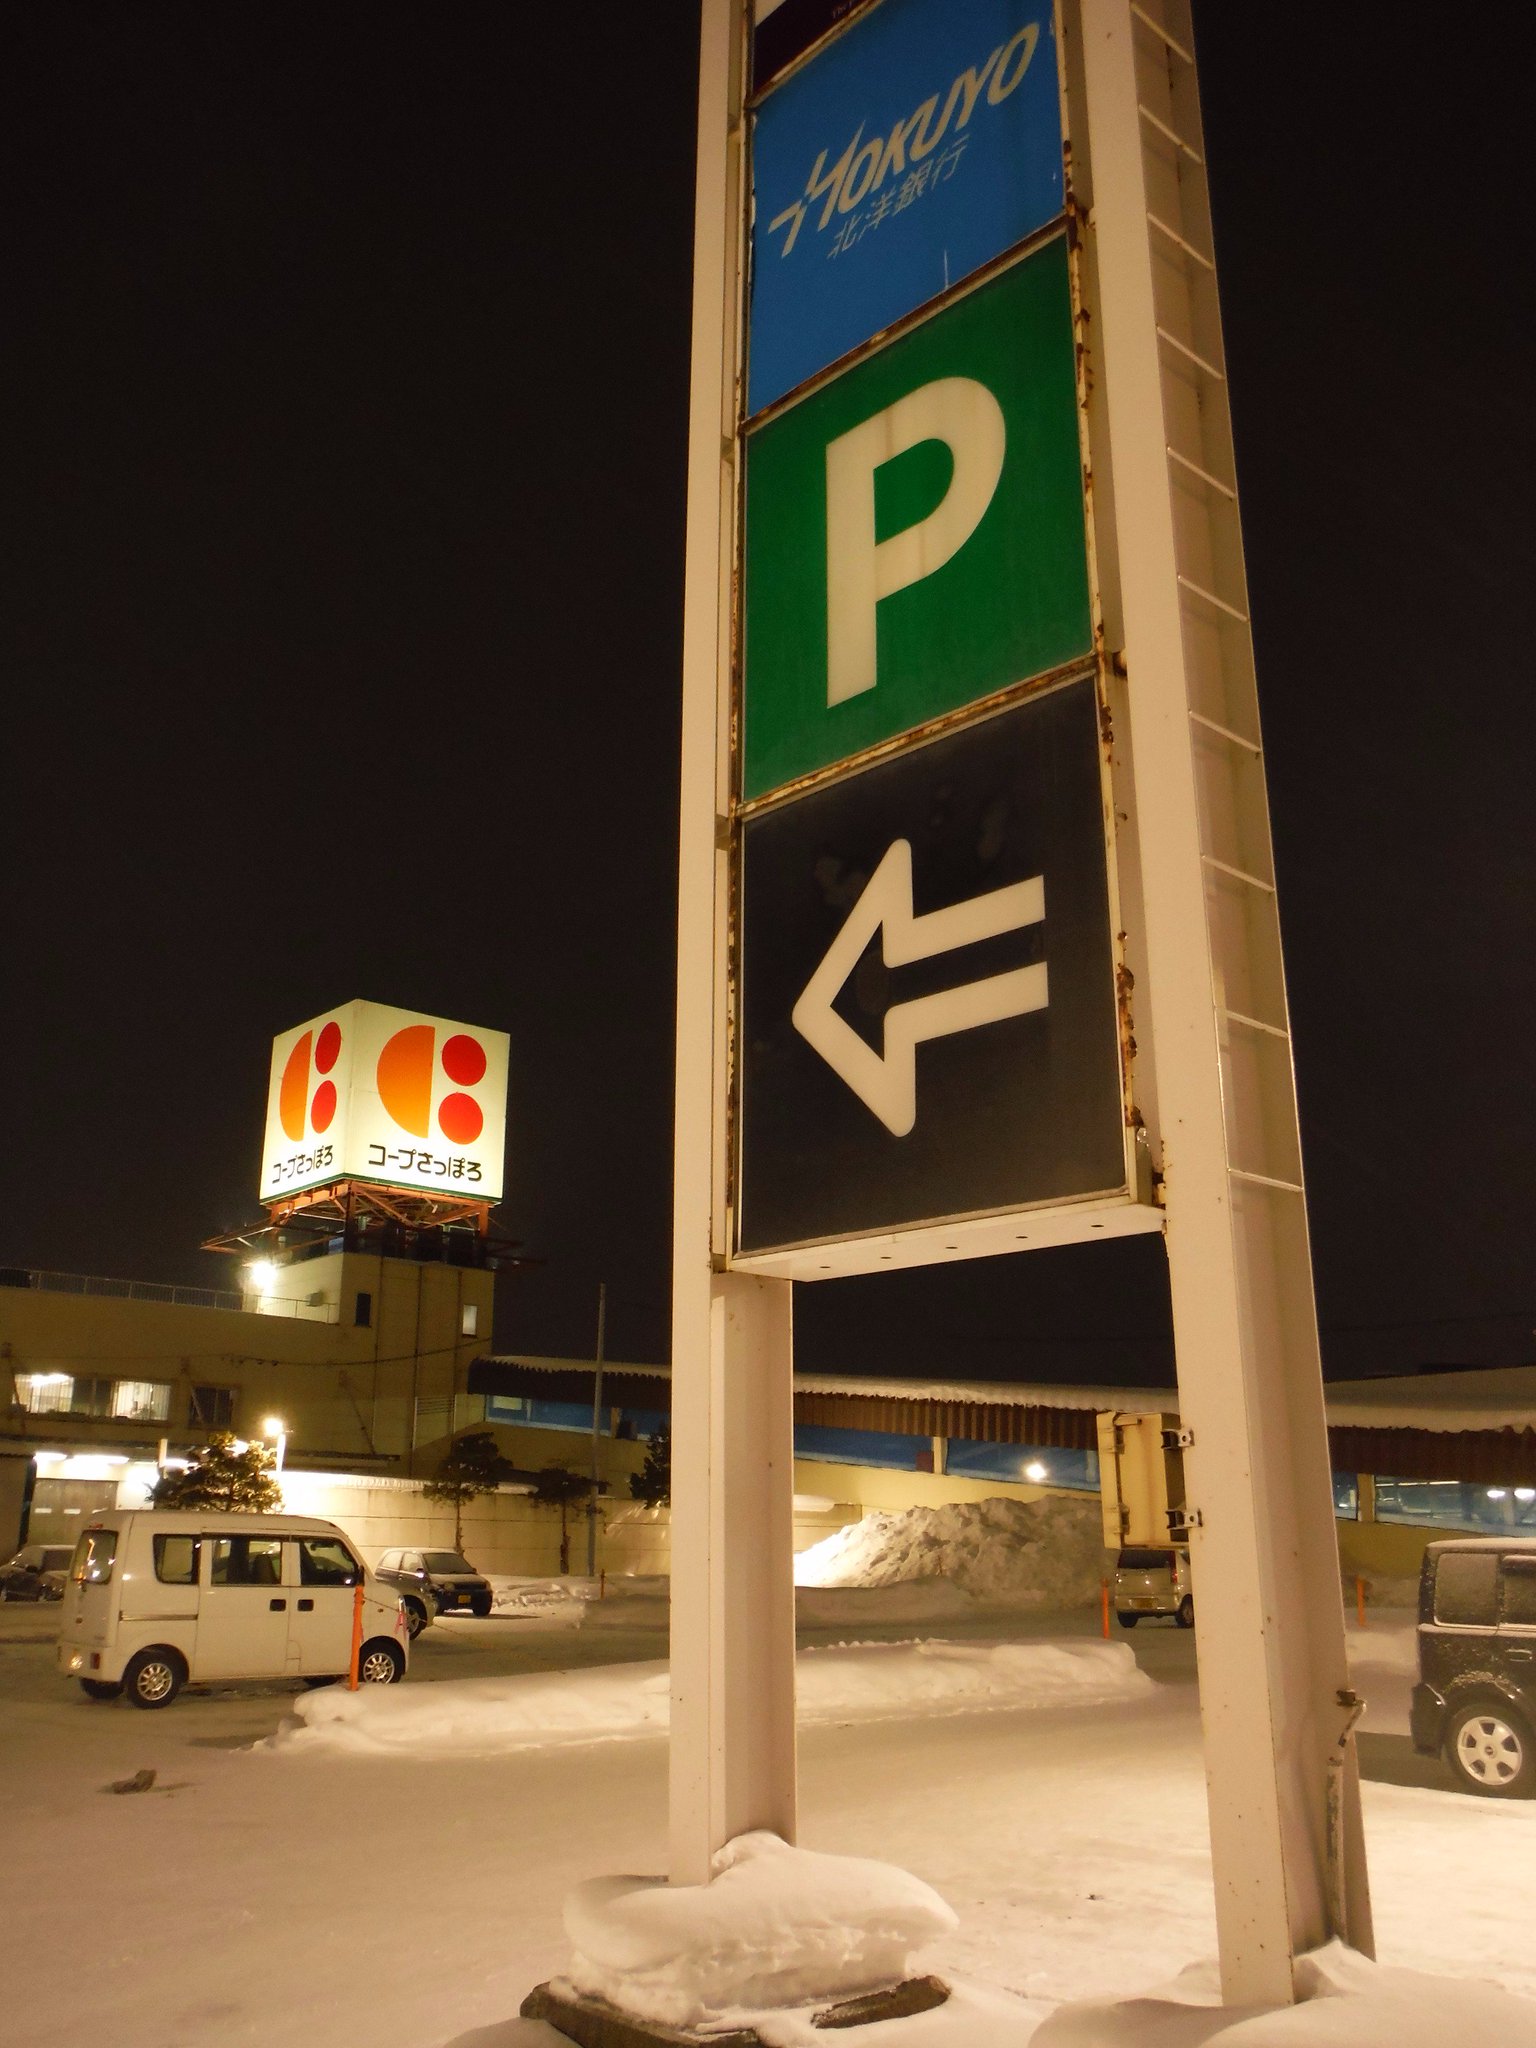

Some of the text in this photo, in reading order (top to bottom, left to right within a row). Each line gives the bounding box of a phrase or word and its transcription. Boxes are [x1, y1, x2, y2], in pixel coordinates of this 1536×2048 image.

[827, 134, 969, 259] 北洋銀行
[826, 377, 1006, 709] P
[272, 1145, 333, 1184] コープさっぽろ
[368, 1144, 482, 1182] コープさっぽろ
